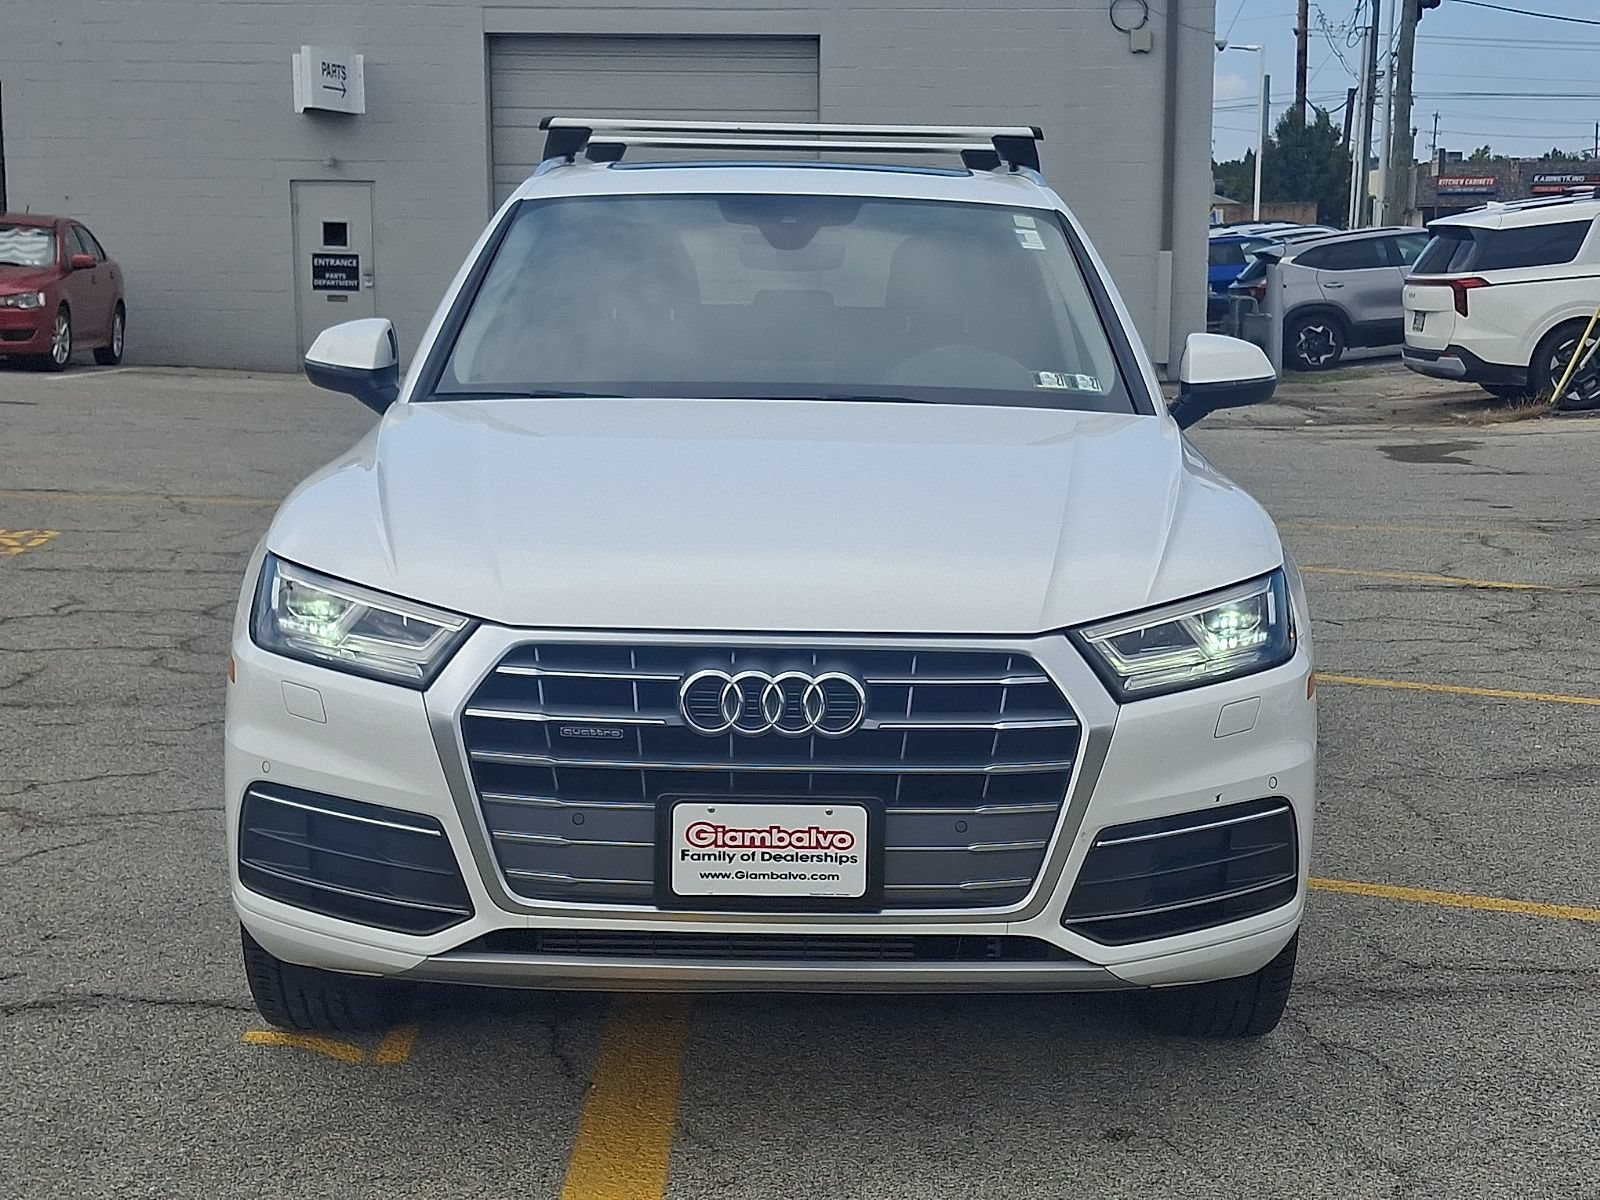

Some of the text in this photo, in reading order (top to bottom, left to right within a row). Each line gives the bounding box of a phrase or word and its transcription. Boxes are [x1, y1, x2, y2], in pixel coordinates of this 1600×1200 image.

[321, 61, 347, 80] PARTS
[313, 257, 357, 267] ENTRANCE
[313, 279, 358, 287] DEPARTMENT
[563, 728, 621, 737] quattro
[685, 821, 855, 850] Giambalvo
[680, 850, 858, 865] Family of Dealerships
[699, 870, 840, 881] www.Giambalvo.com
